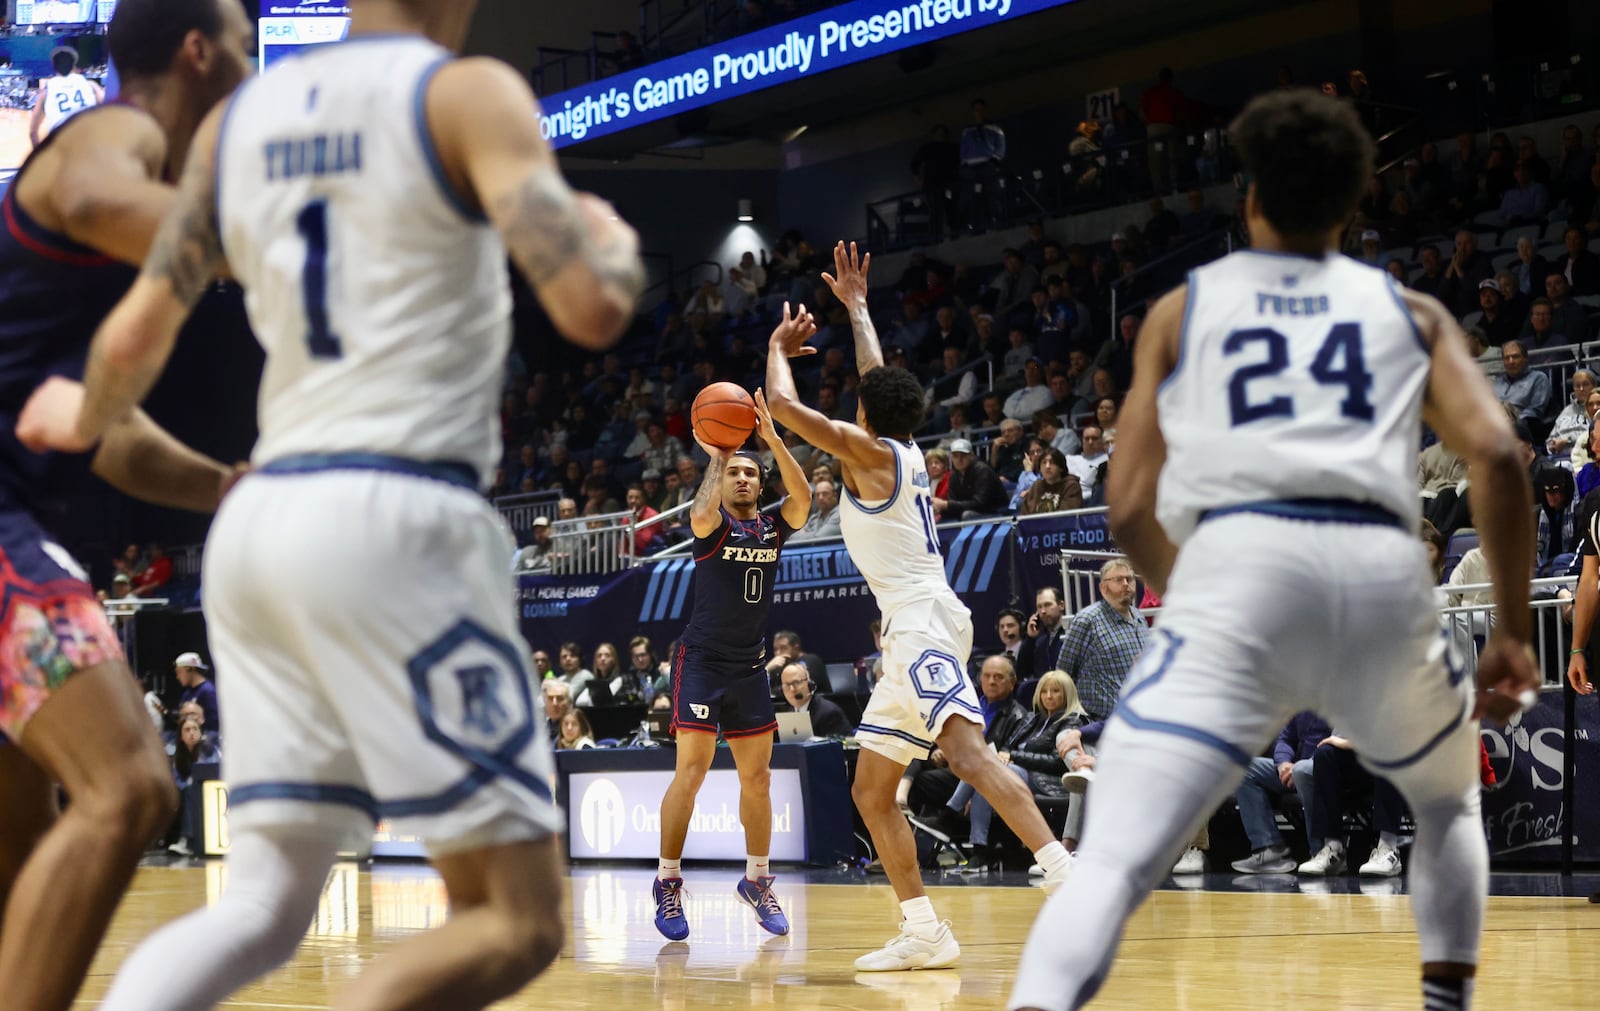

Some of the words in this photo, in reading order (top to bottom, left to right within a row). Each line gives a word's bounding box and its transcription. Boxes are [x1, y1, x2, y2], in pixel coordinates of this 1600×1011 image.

[533, 87, 631, 140] onight's
[633, 67, 709, 112] Game
[713, 31, 815, 88] Proudly
[819, 0, 972, 57] Presented
[56, 89, 87, 112] 24
[296, 199, 343, 357] 1
[1223, 323, 1375, 426] 24
[1042, 532, 1066, 548] OFF
[1070, 528, 1105, 545] FOOD
[722, 546, 778, 563] FLYERS
[1040, 552, 1070, 566] USIN
[538, 586, 566, 599] HOME
[566, 586, 600, 599] GAMES
[744, 567, 764, 604] 0
